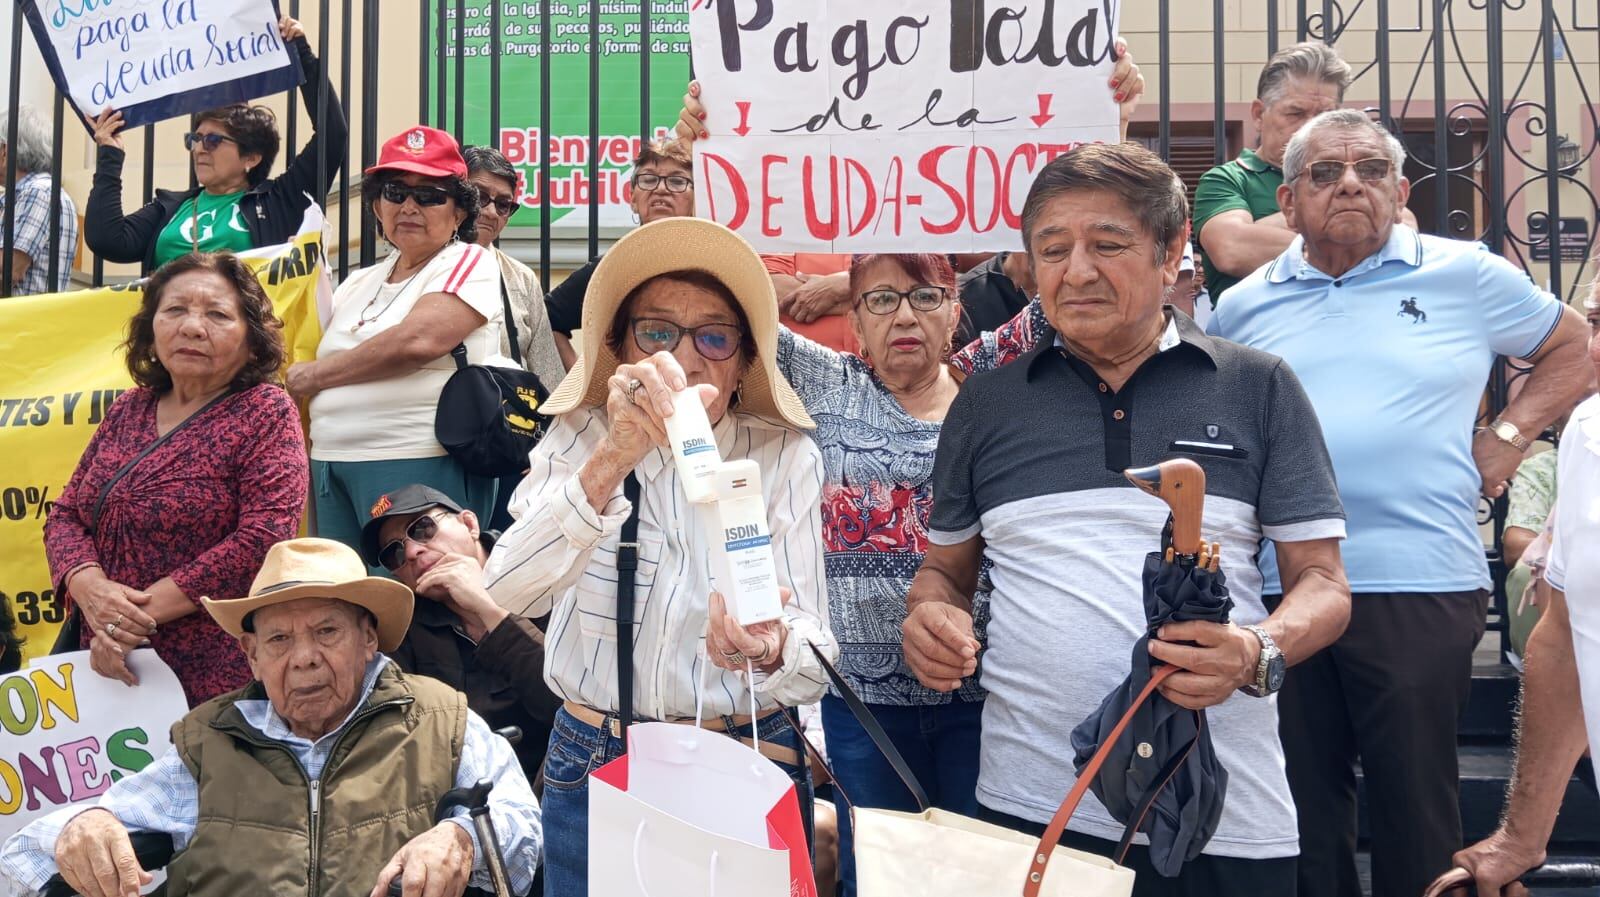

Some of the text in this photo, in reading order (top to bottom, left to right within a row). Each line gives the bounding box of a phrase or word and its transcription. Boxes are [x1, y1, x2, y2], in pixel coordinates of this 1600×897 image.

[504, 3, 518, 16] la
[522, 2, 573, 18] Iglsia,
[577, 1, 642, 18] plnísim
[72, 12, 150, 60] paga
[505, 22, 521, 35] de
[528, 24, 544, 35] su
[557, 23, 618, 37] pecaos,
[624, 19, 690, 37] puiéndo
[91, 22, 281, 106] deuda Social
[604, 40, 642, 56] form
[651, 40, 668, 53] de
[672, 43, 691, 57] su
[705, 0, 929, 100] Pago
[770, 88, 1017, 131] de la
[500, 128, 666, 164] Bienve
[63, 391, 84, 426] Y
[682, 437, 708, 449] ISDIN
[0, 485, 54, 522] 0%
[725, 523, 761, 541] ISDIN
